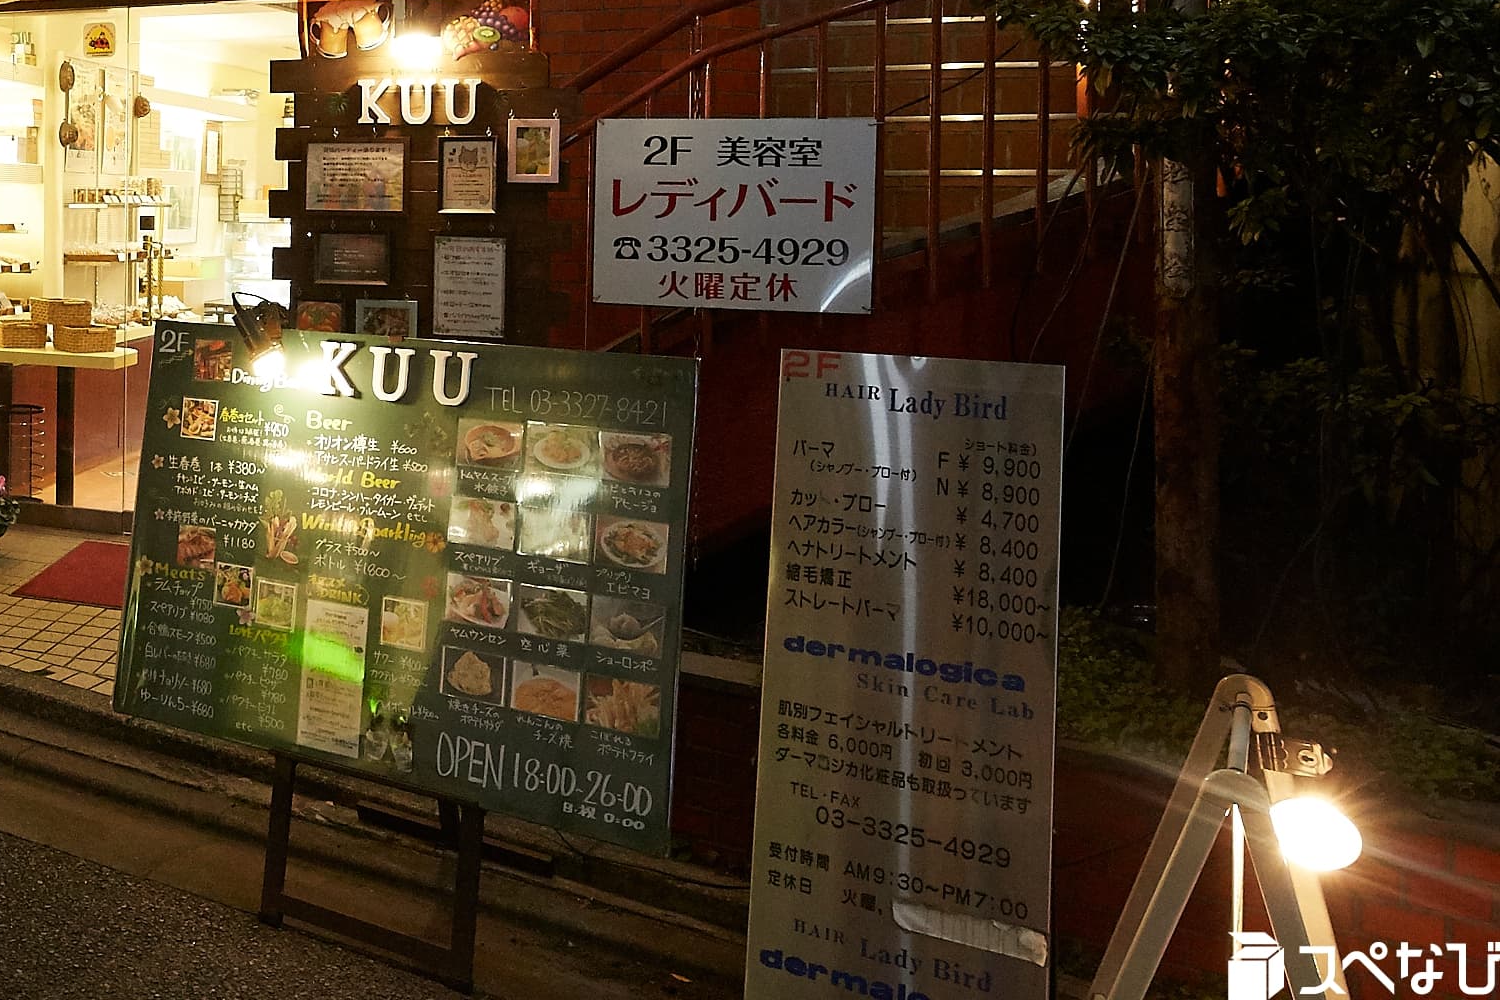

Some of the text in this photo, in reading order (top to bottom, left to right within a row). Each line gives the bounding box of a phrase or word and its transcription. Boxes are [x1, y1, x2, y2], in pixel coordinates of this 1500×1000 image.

[357, 79, 481, 125] KUU
[643, 136, 823, 168] 2F 美容室
[612, 177, 858, 223] レディバード
[658, 271, 798, 301] 火曜定休
[159, 329, 190, 353] 2F
[317, 339, 479, 407] KUU
[783, 351, 842, 379] 2F
[484, 387, 668, 428] TEL 03-3327-8421
[825, 383, 1007, 420] HAIR Lady Bird
[306, 410, 353, 431] Beer
[314, 434, 418, 455] オリオン樽生 ¥600
[169, 455, 201, 472] 生春巻
[402, 459, 429, 473] ¥500
[938, 452, 950, 469] F
[983, 456, 1041, 480] 9,900
[361, 471, 401, 489] Beer
[937, 478, 949, 496] N
[982, 482, 1040, 507] 8,900
[612, 497, 657, 513] アヒージョ
[981, 509, 1039, 533] 4,700
[223, 534, 255, 549] ¥1180
[316, 539, 342, 554] グラス
[980, 536, 1038, 560] 8,400
[314, 555, 346, 570] ボトル
[454, 551, 504, 567] スペアリブ
[527, 560, 569, 575] ギョーザ
[787, 540, 917, 571] ヘナトリートメント
[979, 563, 1037, 588] 8,400
[156, 562, 206, 581] Meats
[786, 563, 852, 588] 縮毛矯正
[155, 577, 204, 597] ラムチョップ
[320, 588, 363, 603] DRINK
[606, 581, 651, 599] エビマヨ
[150, 600, 188, 619] スペアリブ
[450, 627, 507, 646] ヤムウンセン
[596, 651, 658, 672] ショーロンポー
[783, 636, 1025, 692] dermalogica
[857, 673, 1034, 721] Skin Care Lab
[437, 731, 505, 790] OPEN
[777, 723, 818, 746] 各料金
[918, 750, 951, 774] 初回
[603, 812, 646, 831] 0:00
[815, 806, 1012, 868] 03-3325-4929
[769, 842, 830, 871] 受付時間
[767, 870, 812, 894] 定休日
[794, 919, 992, 992] HAIR Lady Bird
